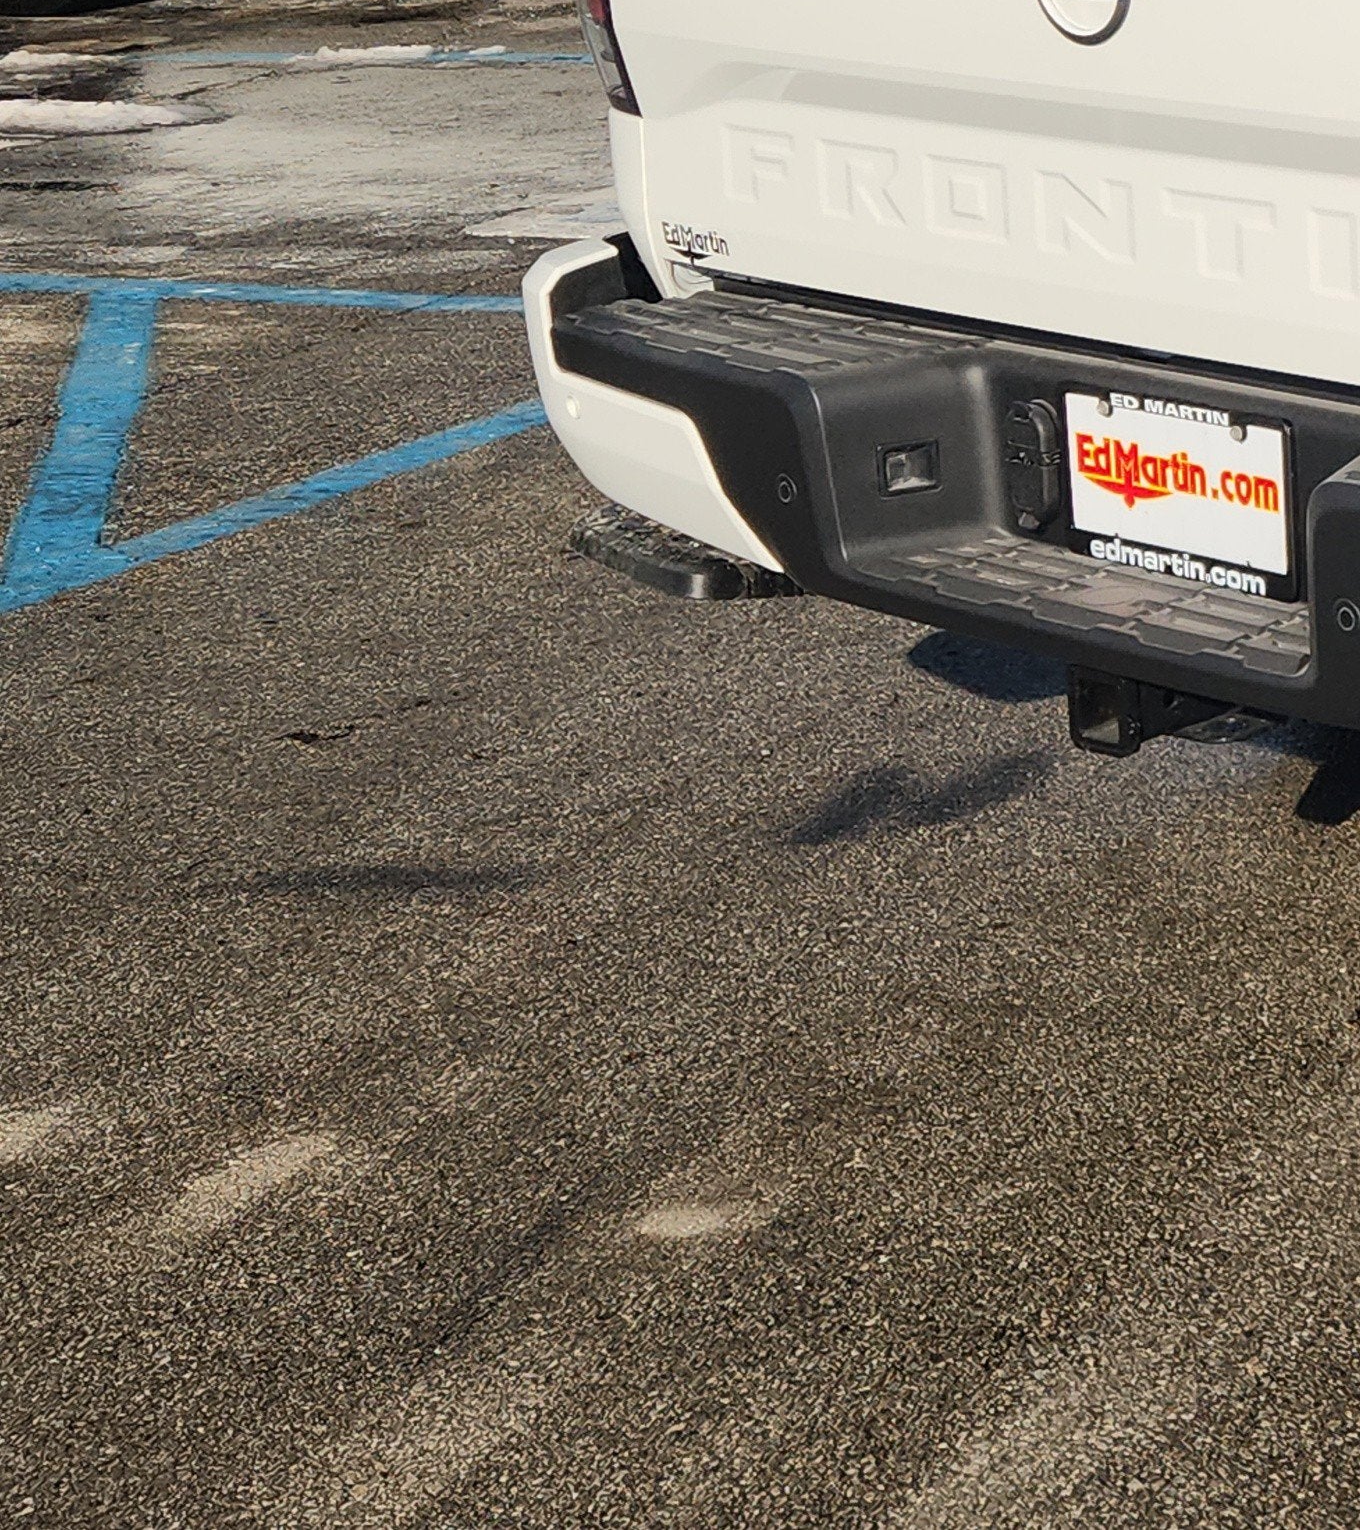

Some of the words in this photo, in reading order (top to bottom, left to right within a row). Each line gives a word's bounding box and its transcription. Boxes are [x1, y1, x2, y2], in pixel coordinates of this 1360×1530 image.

[661, 221, 730, 256] EdMartin
[1110, 392, 1139, 411] ED
[1144, 398, 1230, 427] MARTIN
[1089, 538, 1267, 596] edmartin.com
